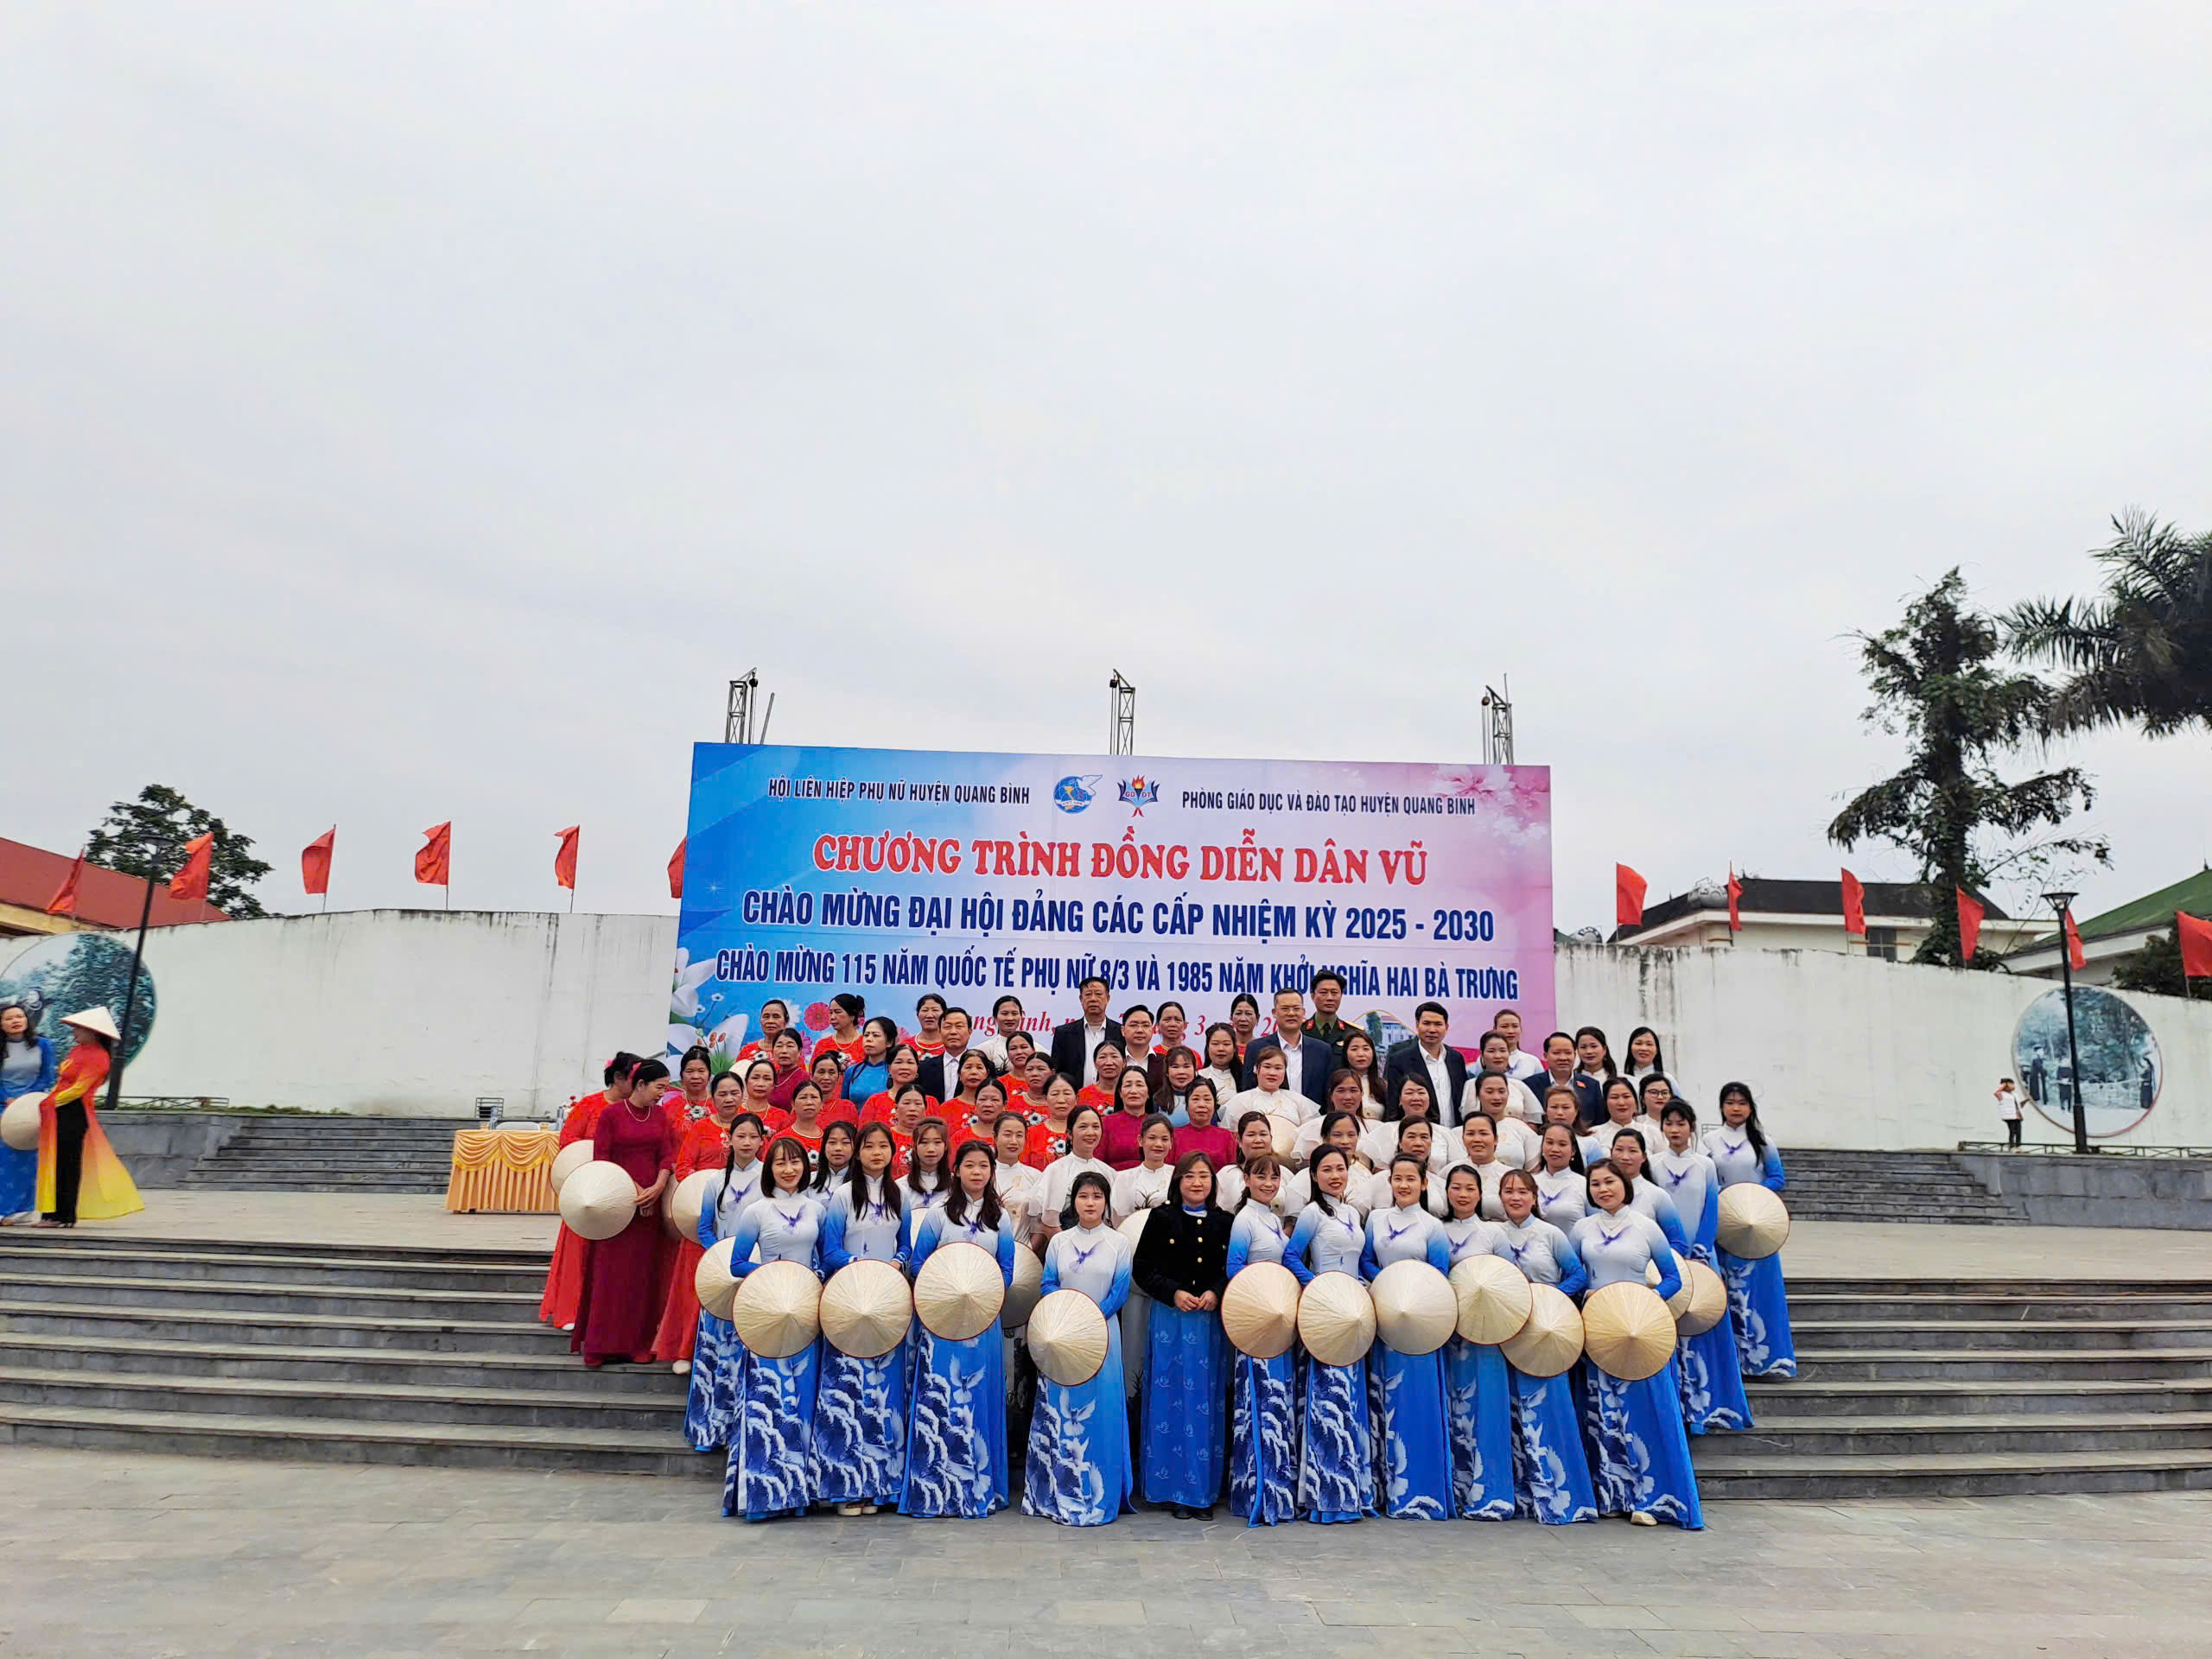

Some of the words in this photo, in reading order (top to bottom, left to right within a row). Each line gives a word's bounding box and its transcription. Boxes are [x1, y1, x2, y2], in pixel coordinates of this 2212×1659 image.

[768, 775, 791, 801] HỘI
[795, 776, 822, 798] LIÊN
[826, 777, 855, 803] HIỆP
[859, 782, 885, 804] PHỤ
[910, 780, 950, 805] HUYỆN
[955, 785, 995, 804] QUANG
[1001, 782, 1030, 804] BÌNH
[1182, 787, 1223, 809] PHÒNG
[1228, 788, 1255, 810] GIÁO
[1259, 793, 1283, 814] DỤC
[1287, 790, 1302, 811] VÀ
[1306, 790, 1330, 812] ĐÀO
[1334, 795, 1357, 817] TẠO
[1361, 792, 1399, 817] HUYỆN
[1404, 797, 1443, 816] QUANG
[814, 830, 961, 874] CHƯƠNG
[971, 830, 1081, 876] TRÌNH
[1090, 825, 1190, 880] ĐỒNG
[1199, 828, 1284, 882] DIỄN
[1294, 838, 1369, 884] DÂN
[1378, 840, 1428, 886] VŨ
[743, 886, 813, 925] CHÀO
[821, 887, 900, 928] MỪNG
[908, 897, 951, 936] ĐẠI
[961, 893, 1003, 938] HỘI
[1012, 888, 1084, 932] ĐẢNG
[1092, 894, 1144, 934] CÁC
[1153, 892, 1204, 936] CẤP
[1212, 898, 1296, 944] NHIỆM
[1306, 899, 1338, 938] KỲ
[1345, 907, 1408, 940] 2025
[1433, 909, 1494, 942] 2030
[716, 944, 770, 982] CHÀO
[775, 945, 835, 983] MỪNG
[842, 954, 877, 984] 115
[882, 948, 929, 985] NĂM
[935, 945, 987, 989] QUỐC
[994, 947, 1017, 988] TẾ
[1021, 957, 1060, 995] PHỤ
[1100, 959, 1129, 990] 8/3
[1135, 954, 1160, 991] VÀ
[1166, 961, 1213, 993] 1985
[1219, 957, 1263, 994] NĂM
[1322, 960, 1381, 996] HĨA
[1387, 966, 1418, 997] HAI
[1425, 962, 1450, 998] BÀ
[1455, 967, 1518, 1001] TRƯNG
[1194, 1014, 1206, 1035] 3
